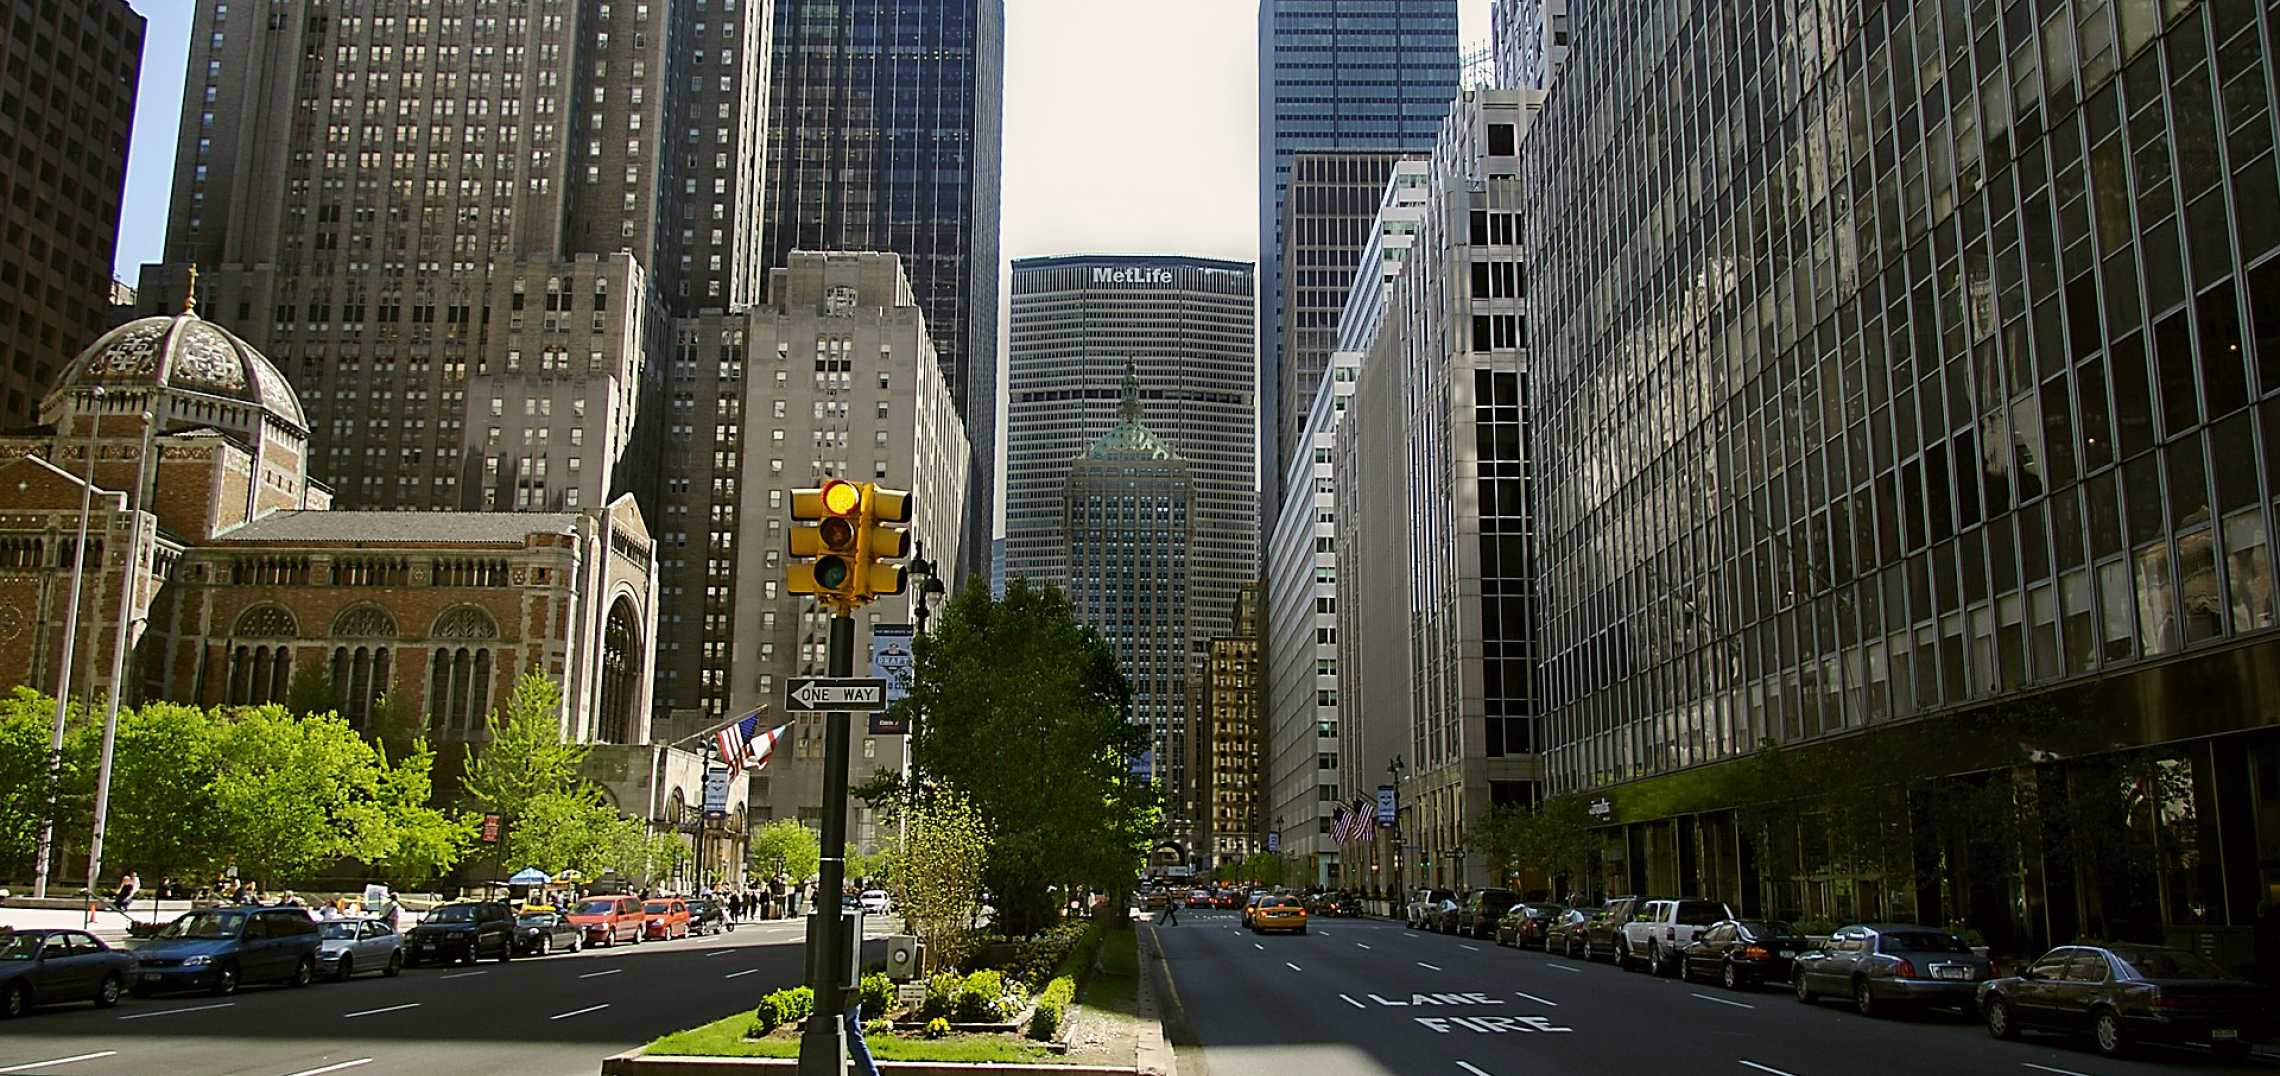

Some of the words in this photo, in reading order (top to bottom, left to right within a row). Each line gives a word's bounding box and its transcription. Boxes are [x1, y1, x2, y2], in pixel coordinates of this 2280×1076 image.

[1093, 266, 1172, 283] MetLife
[801, 688, 830, 701] ONE
[843, 688, 874, 701] WAY
[1367, 993, 1504, 1005] LANE
[1413, 1016, 1573, 1032] FIRE
